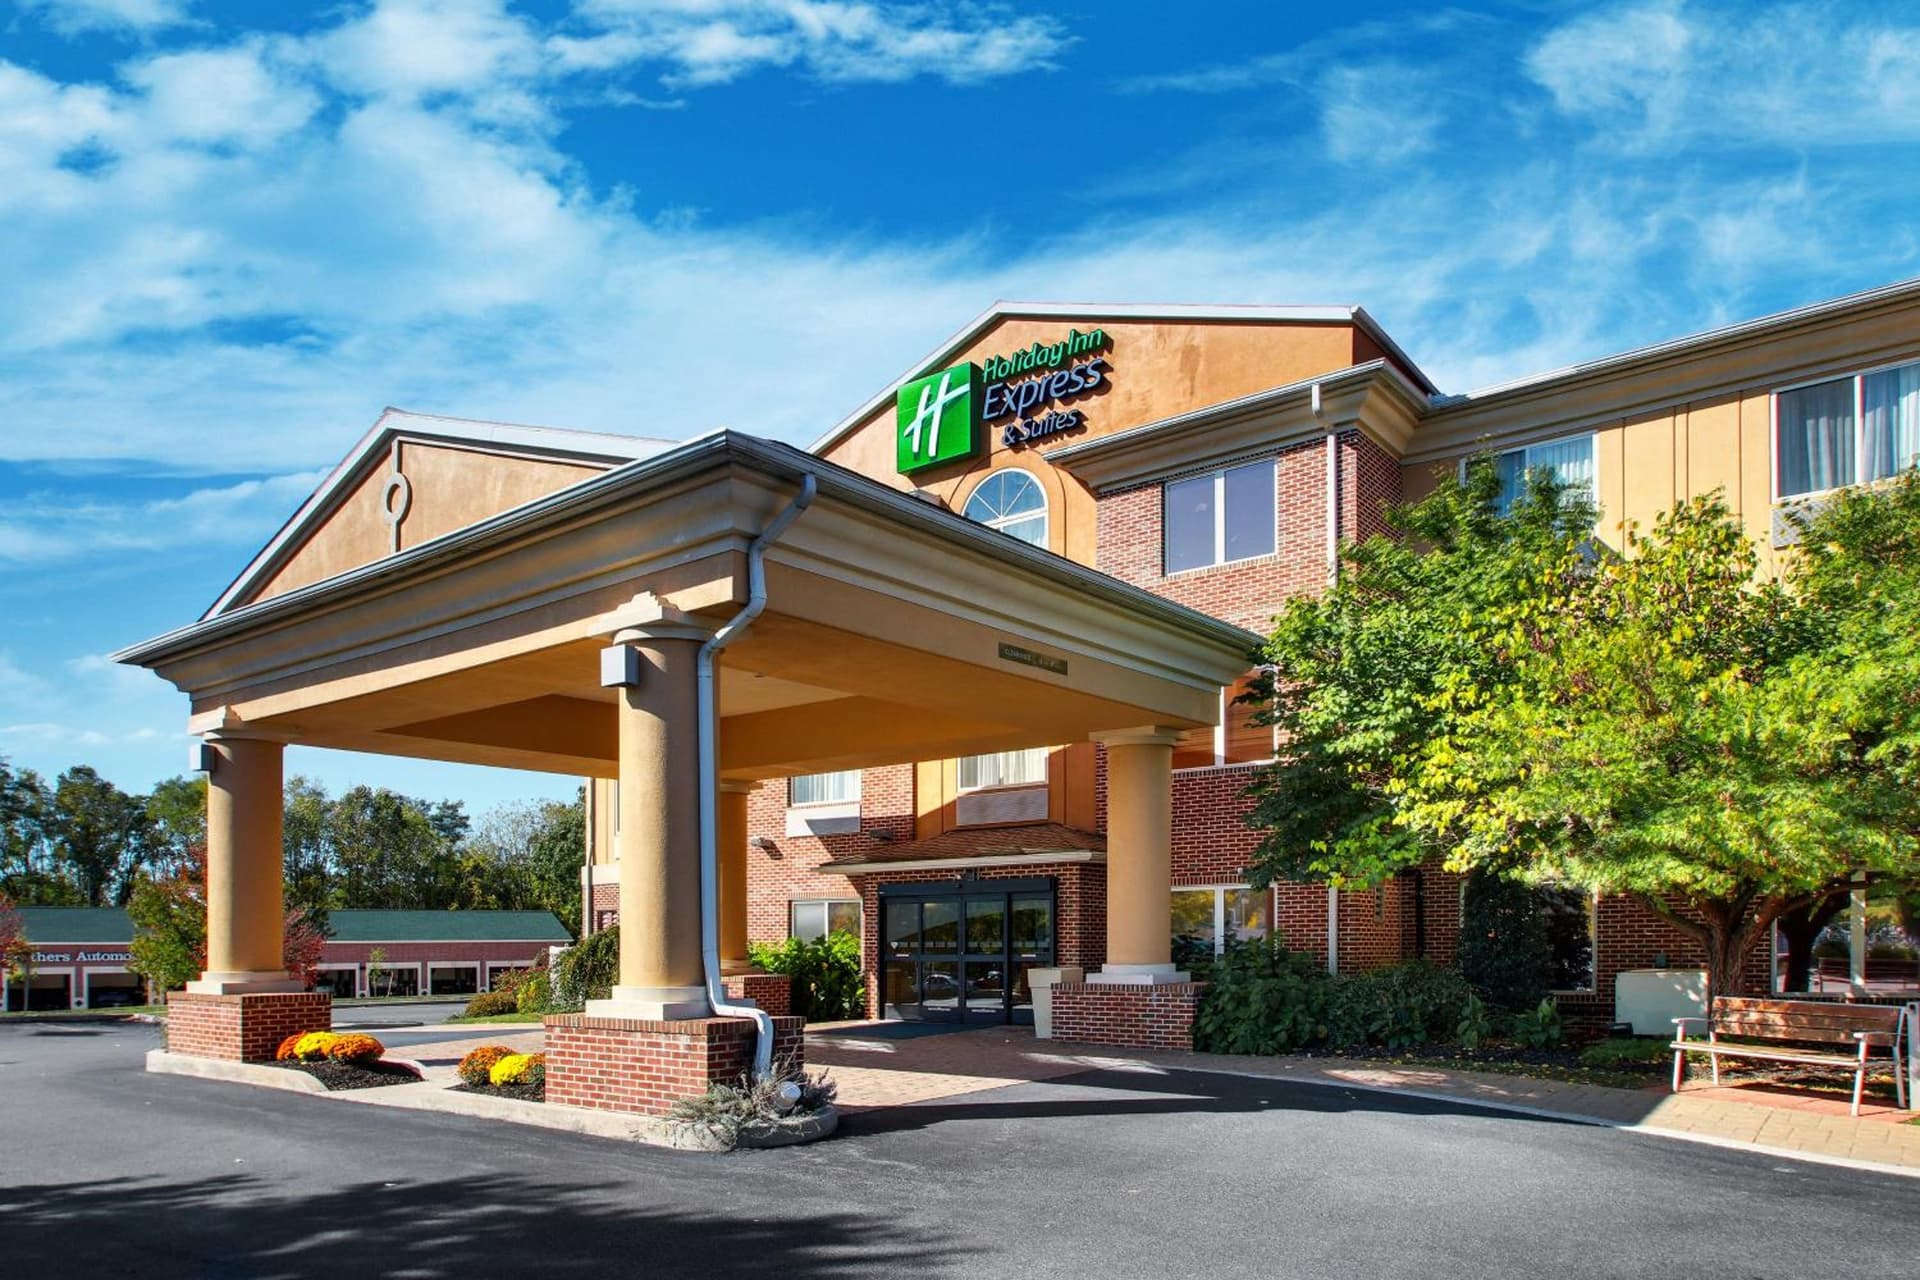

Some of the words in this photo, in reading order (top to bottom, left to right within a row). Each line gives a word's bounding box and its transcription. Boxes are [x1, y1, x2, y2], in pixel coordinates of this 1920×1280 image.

[982, 341, 1064, 383] Holiday
[1067, 328, 1103, 356] Inn
[983, 358, 1102, 420] Express
[1003, 423, 1016, 445] &
[1020, 409, 1078, 441] Suites
[76, 951, 136, 962] Automo
